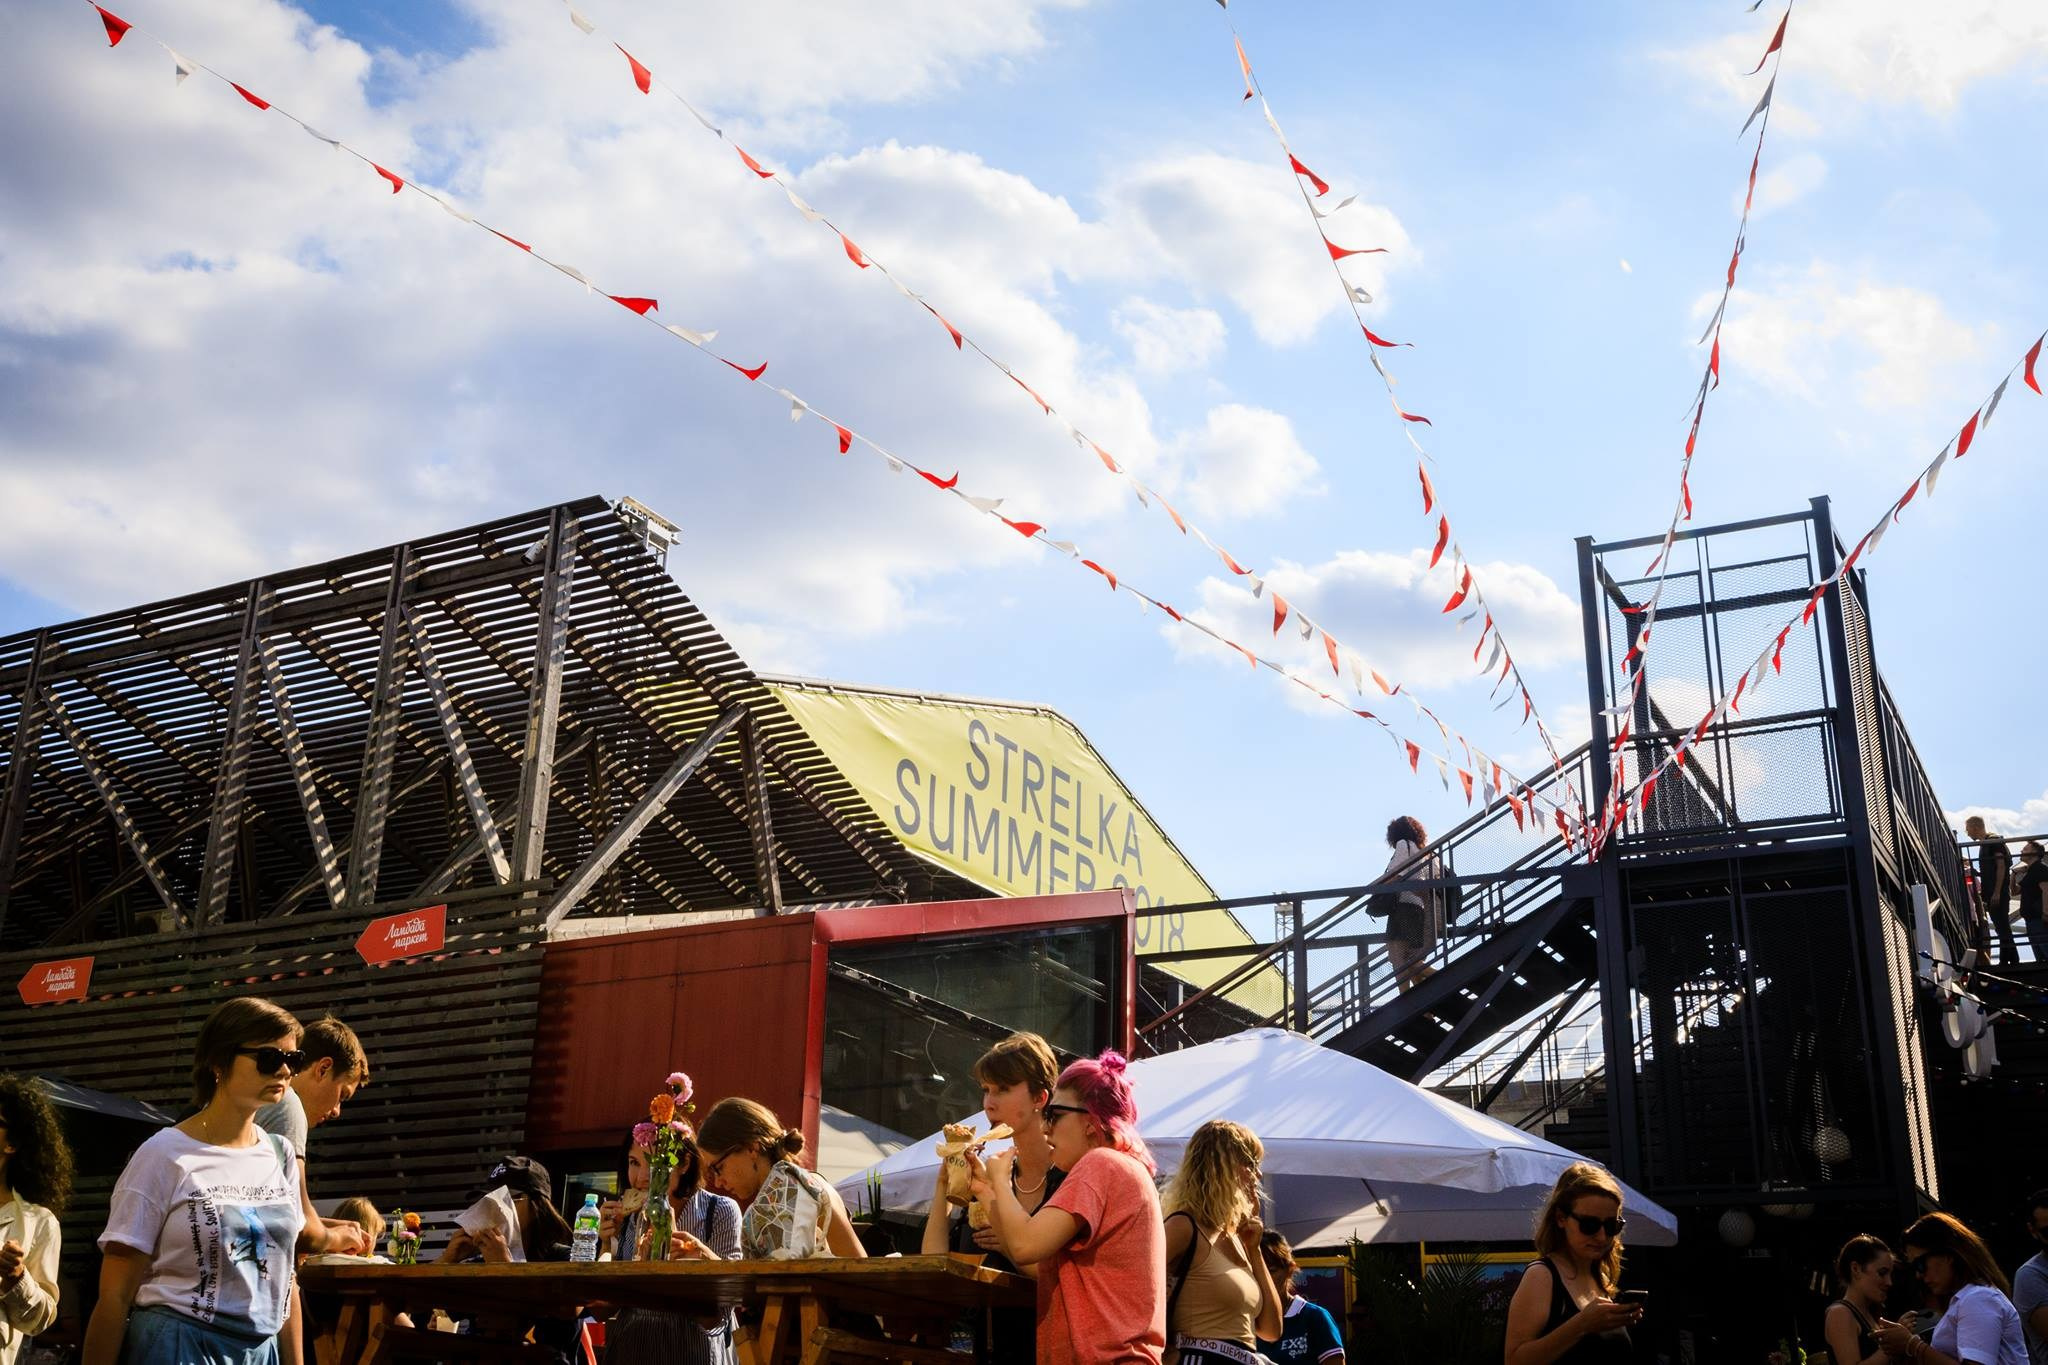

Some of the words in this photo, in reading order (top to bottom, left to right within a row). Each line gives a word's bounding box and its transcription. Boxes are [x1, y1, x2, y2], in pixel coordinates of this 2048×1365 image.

[966, 719, 1143, 877] STRELKA
[384, 917, 426, 942] Ламбада
[392, 932, 428, 951] маркет
[41, 966, 76, 985] Ламбада
[46, 981, 76, 995] маркет
[1200, 1339, 1217, 1349] ОФ
